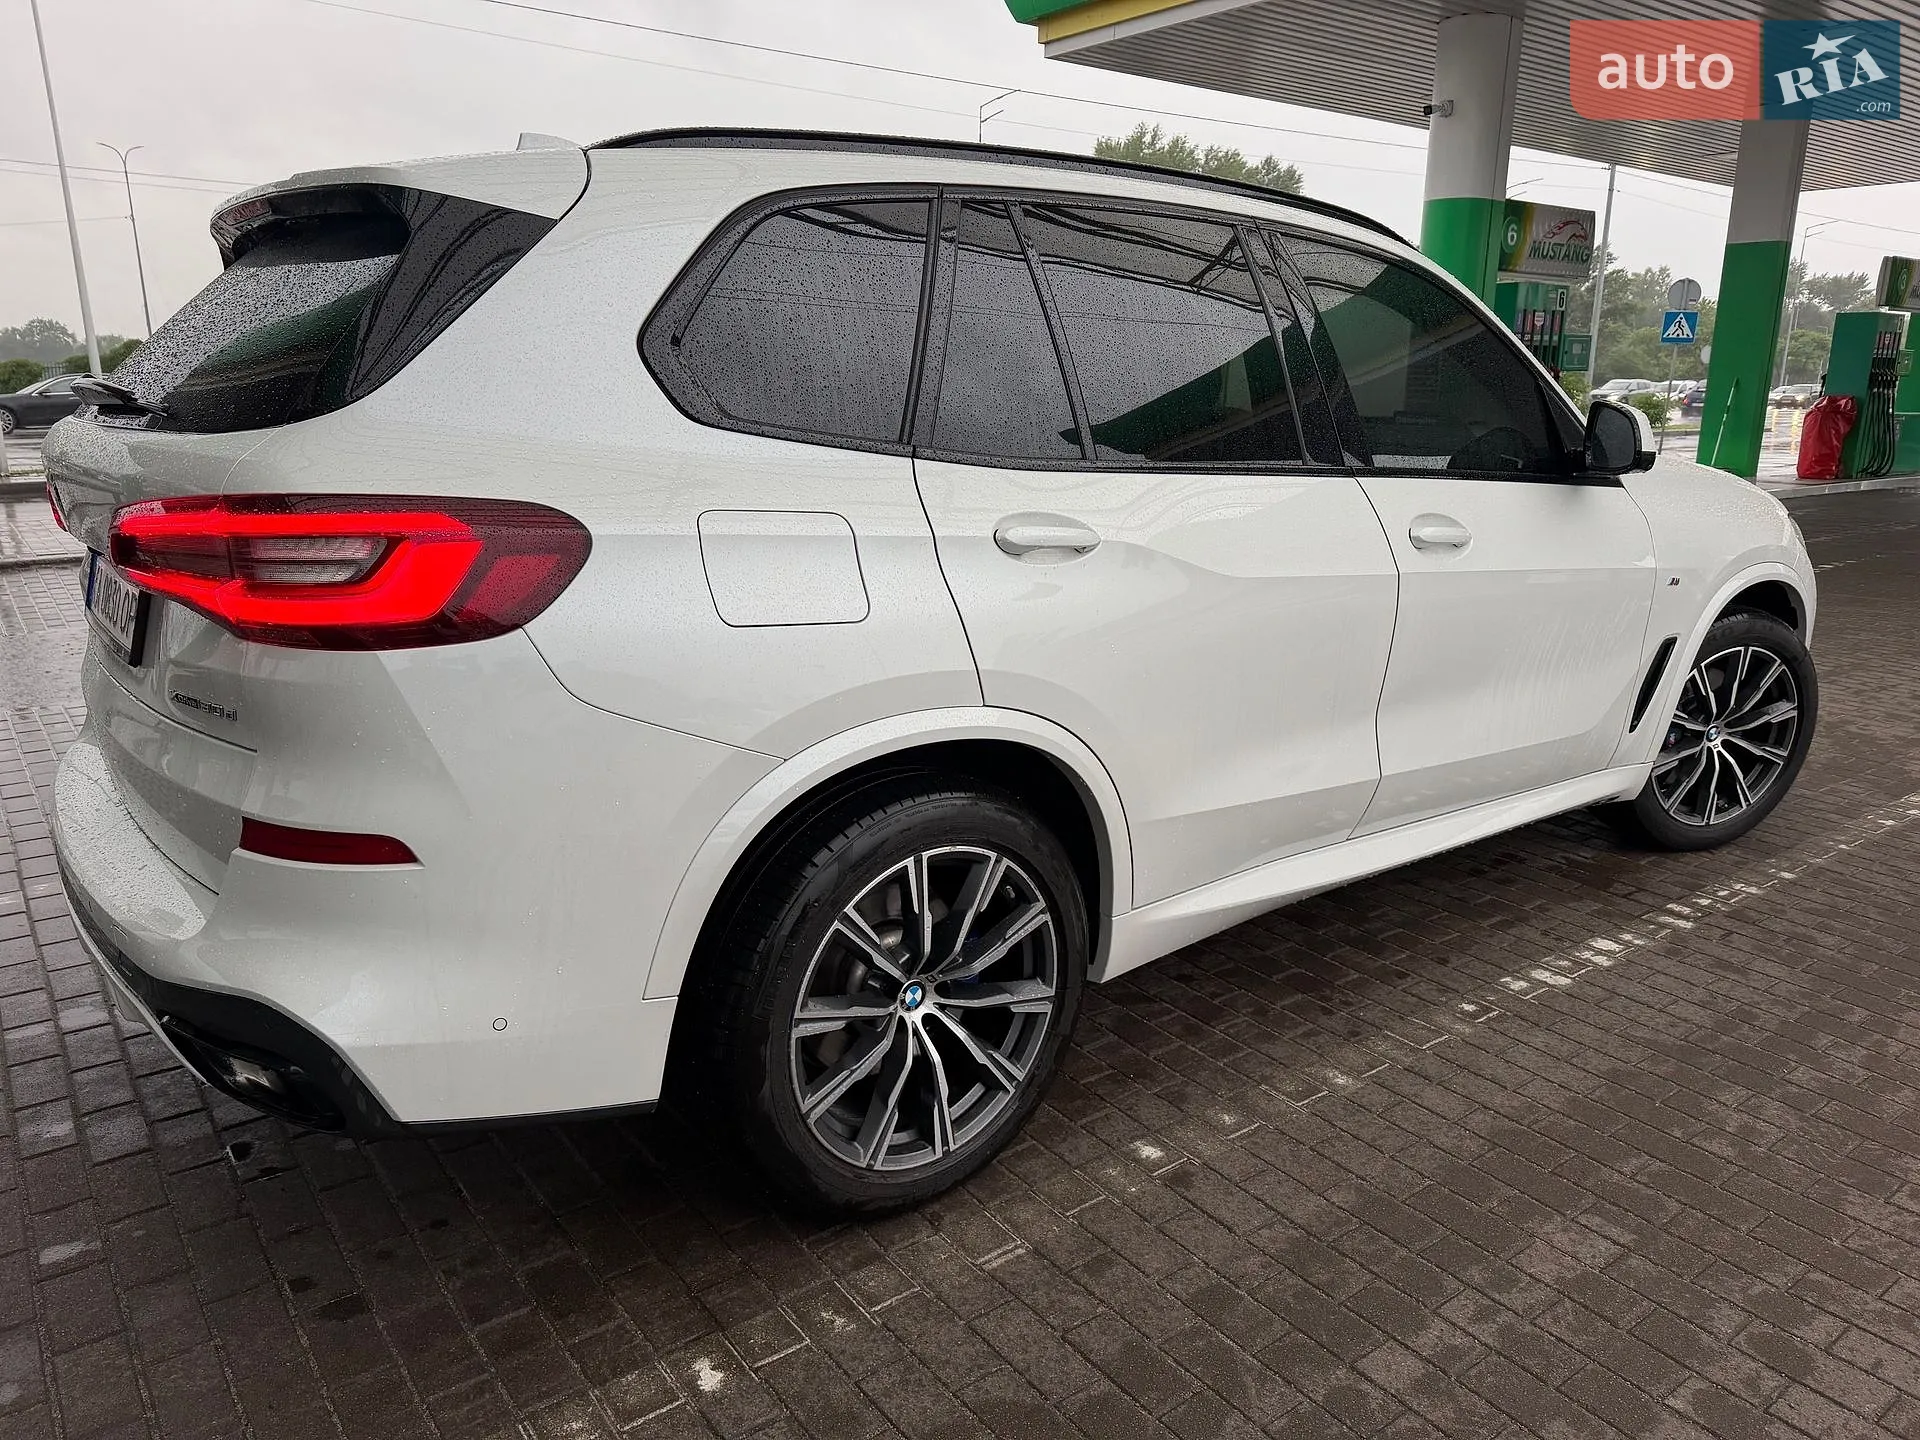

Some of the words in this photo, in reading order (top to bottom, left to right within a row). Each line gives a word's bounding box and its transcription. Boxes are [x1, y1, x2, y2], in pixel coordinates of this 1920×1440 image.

[1507, 223, 1518, 246] 6
[1528, 240, 1591, 264] MUSTANG
[1559, 291, 1566, 309] 6
